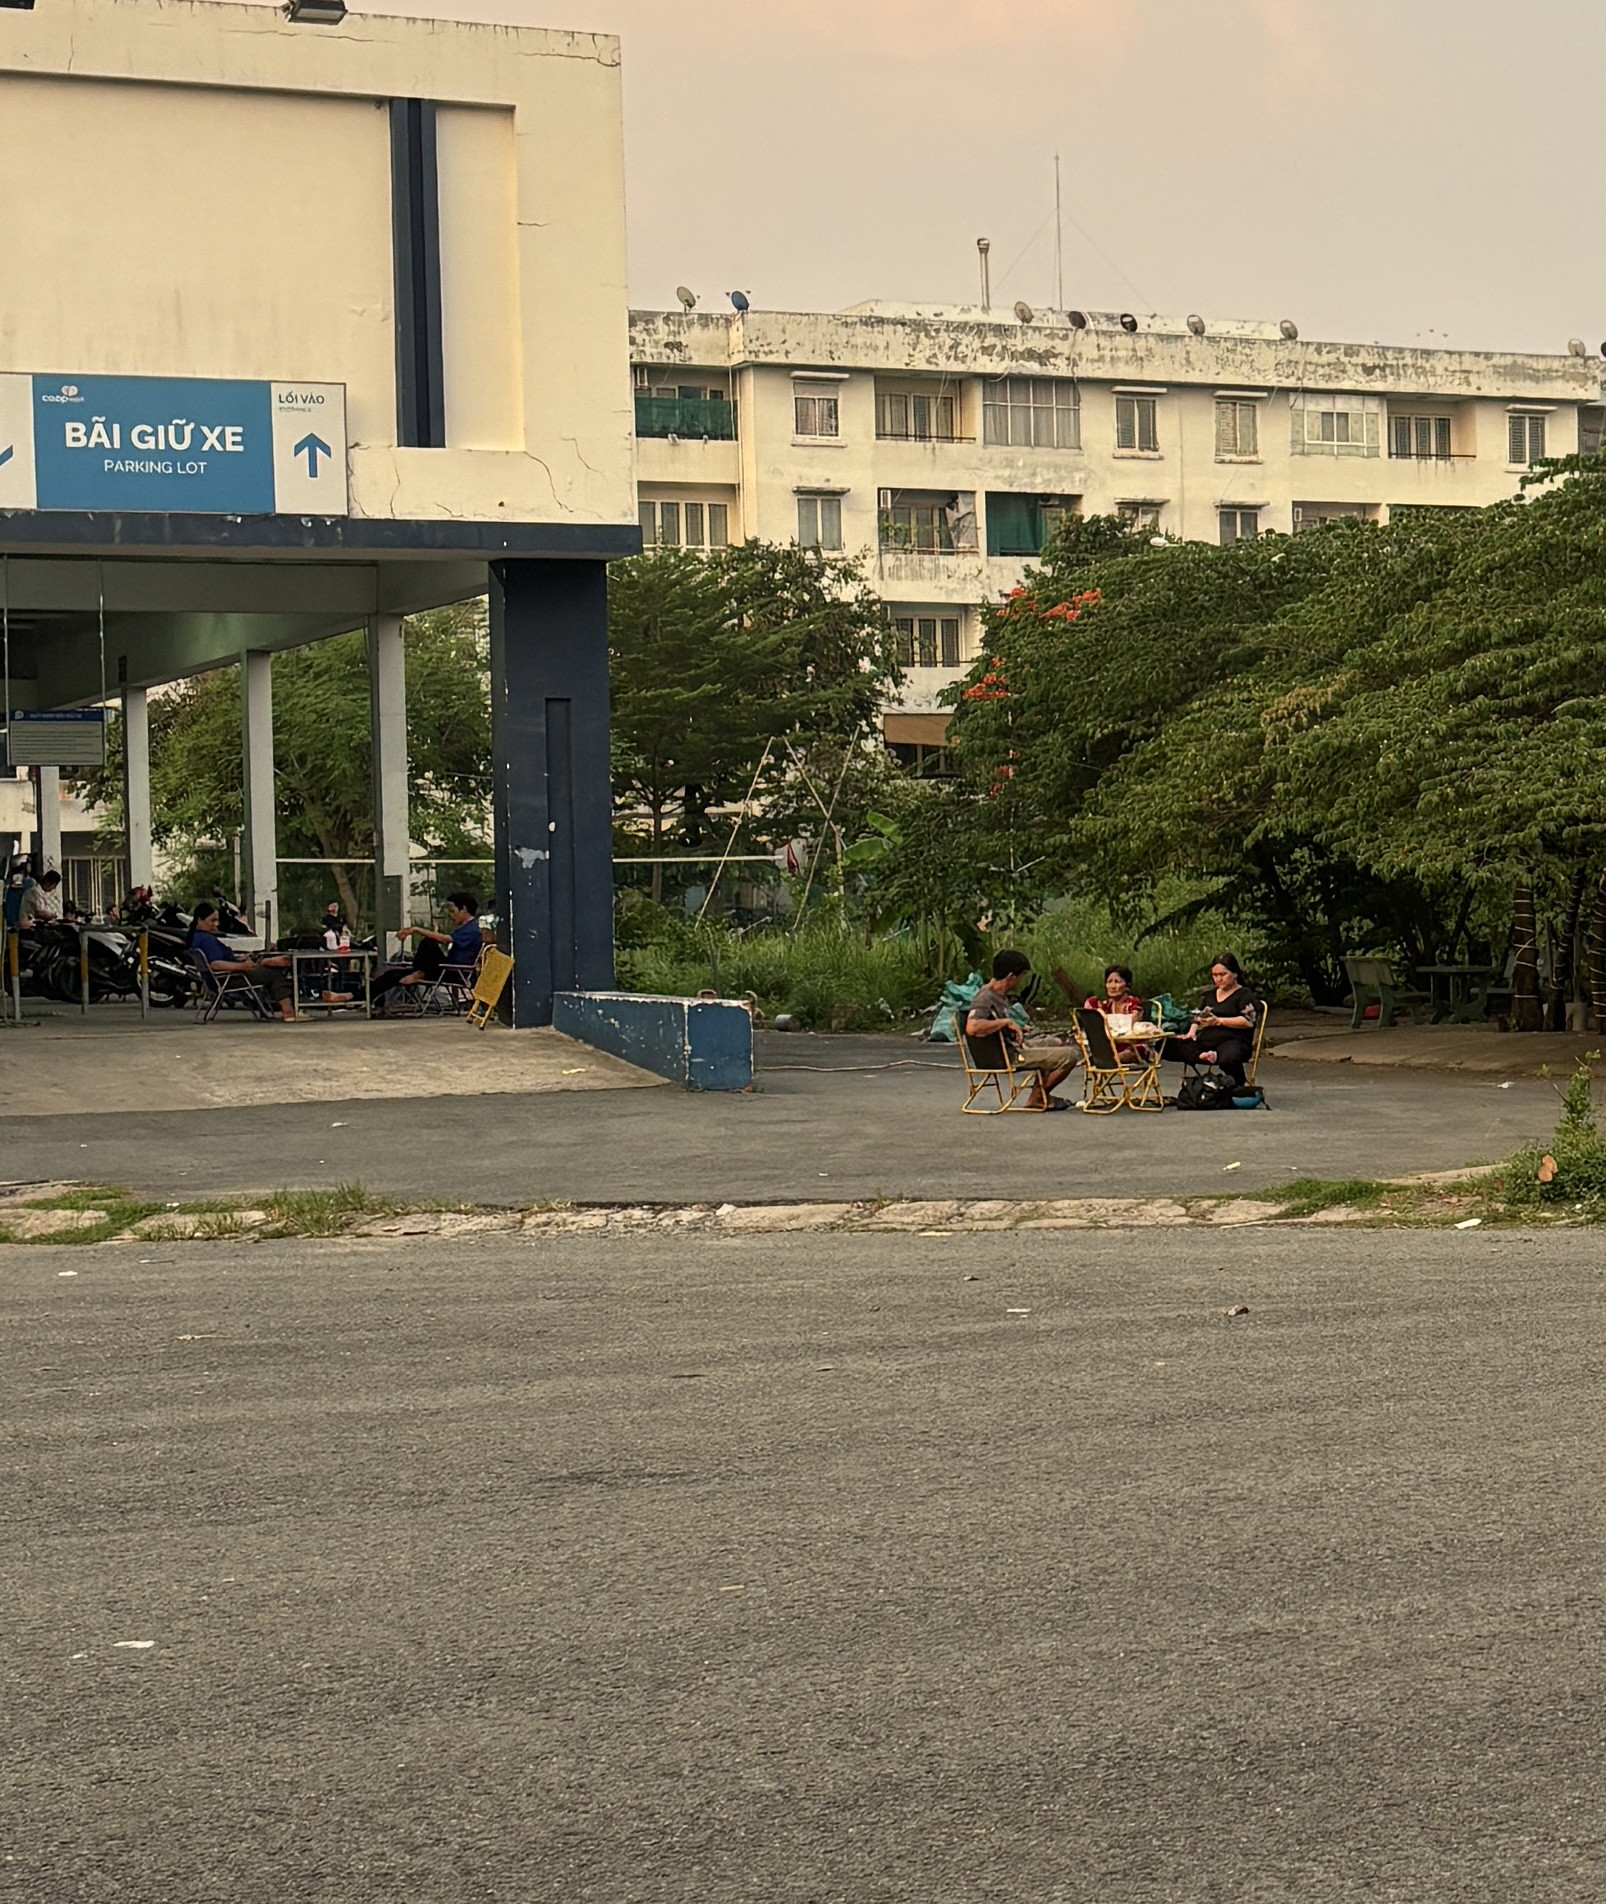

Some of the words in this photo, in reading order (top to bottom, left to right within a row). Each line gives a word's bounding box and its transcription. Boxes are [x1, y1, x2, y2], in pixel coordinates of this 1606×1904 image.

[300, 392, 325, 405] VÀO
[65, 416, 121, 449] BÃI
[131, 418, 195, 451] GIỮ
[200, 426, 244, 452] XE
[104, 459, 173, 474] PARKING
[177, 461, 208, 474] LOT
